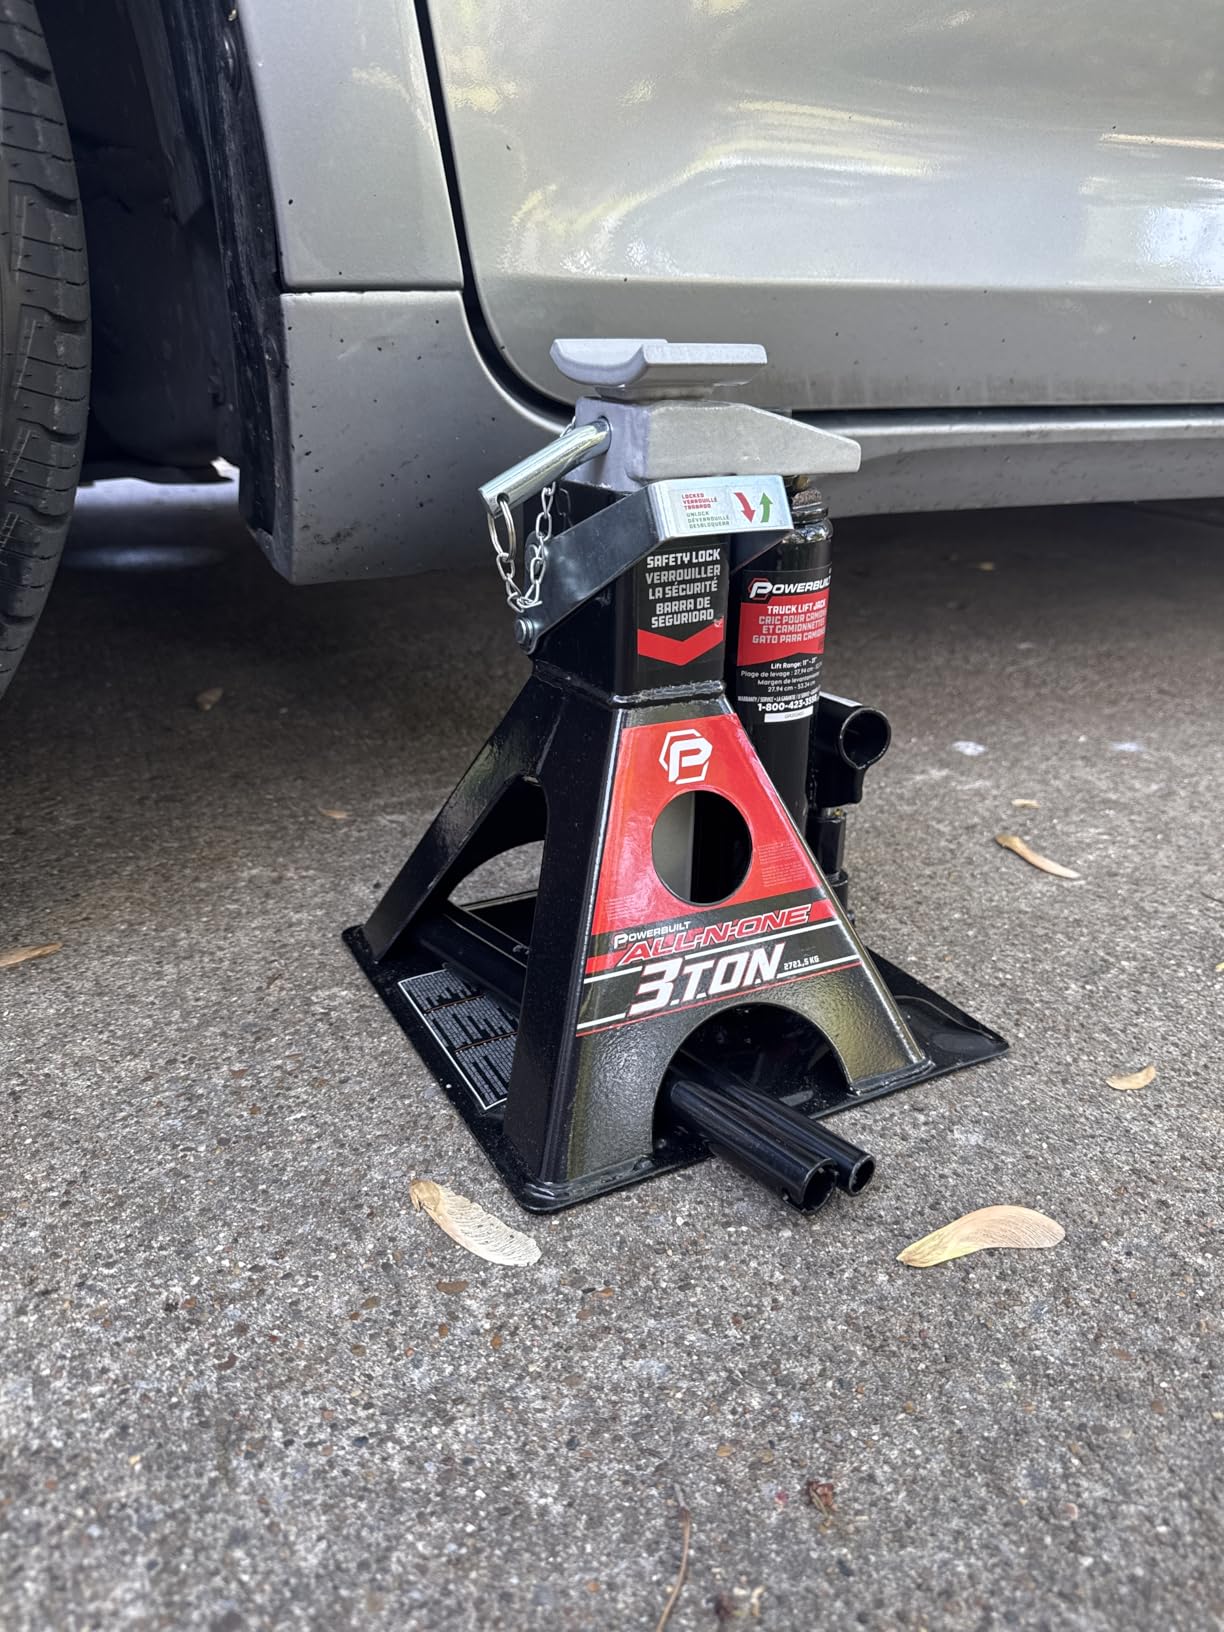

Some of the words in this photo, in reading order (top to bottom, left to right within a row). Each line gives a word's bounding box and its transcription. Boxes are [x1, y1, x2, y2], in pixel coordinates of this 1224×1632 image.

[646, 552, 690, 569] SAFETY
[692, 548, 721, 563] LOCK
[645, 564, 721, 584] VERROUILLER
[648, 587, 663, 600] LA
[665, 577, 718, 597] SÉCURITÉ
[656, 599, 695, 615] BARRA
[696, 596, 711, 609] DE
[767, 604, 797, 614] TRUCK
[798, 602, 813, 613] LIFT
[651, 609, 714, 628] SEGURIDAD
[758, 615, 781, 624] CRIC
[782, 613, 805, 623] POUR
[762, 625, 774, 634] ET
[752, 634, 778, 644] GATO
[779, 633, 802, 643] PARA
[741, 670, 759, 678] Plage
[770, 670, 790, 678] levage
[757, 679, 782, 687] Margen
[613, 920, 692, 949] POWERBUILT
[783, 958, 809, 970] 2721,5
[809, 955, 820, 965] KG
